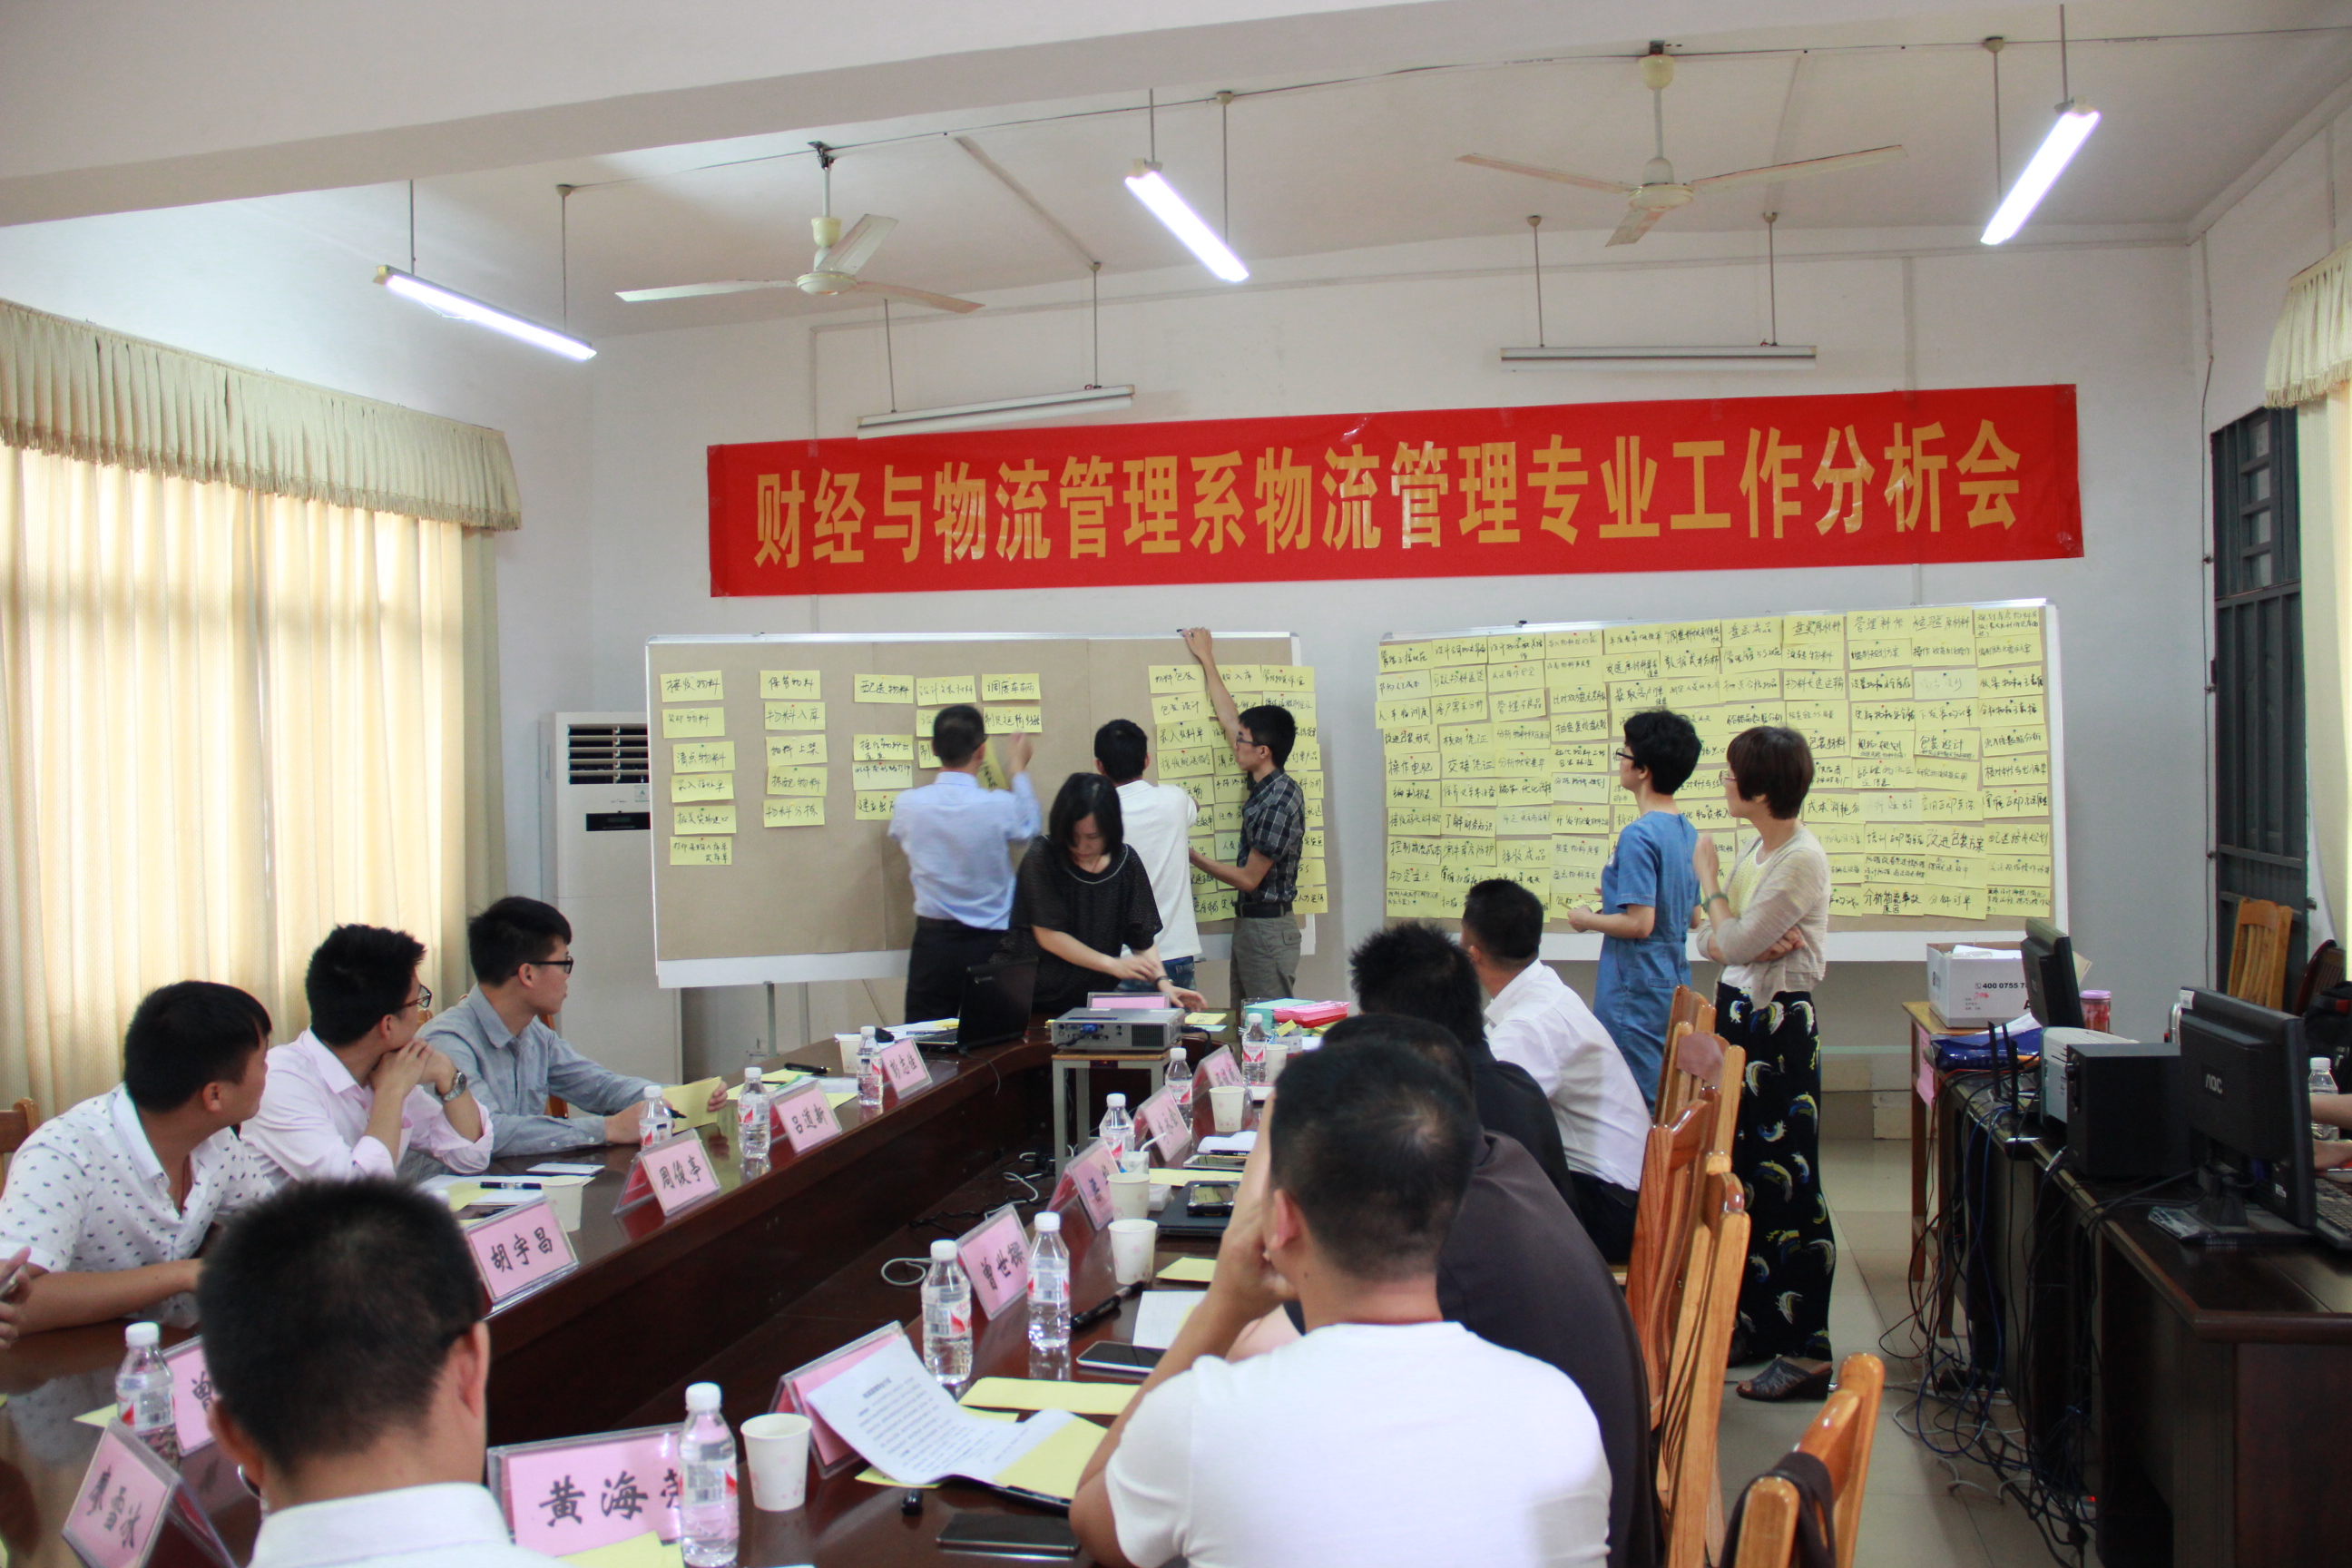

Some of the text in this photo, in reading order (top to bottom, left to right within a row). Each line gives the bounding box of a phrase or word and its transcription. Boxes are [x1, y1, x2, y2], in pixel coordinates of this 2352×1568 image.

[752, 418, 2021, 569] 财经与物流管理系物流管理专业工作分析会
[1728, 622, 1772, 640] 盘点成品
[666, 678, 720, 695] 接收物料
[769, 676, 814, 692] 保管物料
[861, 681, 909, 698] 配送物料
[987, 680, 1034, 694] 调度车辆
[1436, 699, 1484, 717] 客户需求分析
[766, 709, 819, 725] 物料入库
[1443, 733, 1489, 746] 核对凭证
[1920, 736, 1963, 753] 包装设计
[771, 742, 819, 758] 物料上架
[677, 752, 726, 768] 清点物料
[1388, 760, 1433, 776] 操作电脑
[1447, 755, 1495, 773] 交接凭证
[1446, 814, 1493, 832] 了解财务知识
[1926, 829, 1984, 852] 改进包装方案
[1502, 847, 1546, 864] 接收成品
[2205, 1073, 2223, 1094] AOC
[660, 1155, 701, 1190] 周俊亭
[491, 1227, 553, 1272] 胡宇昌
